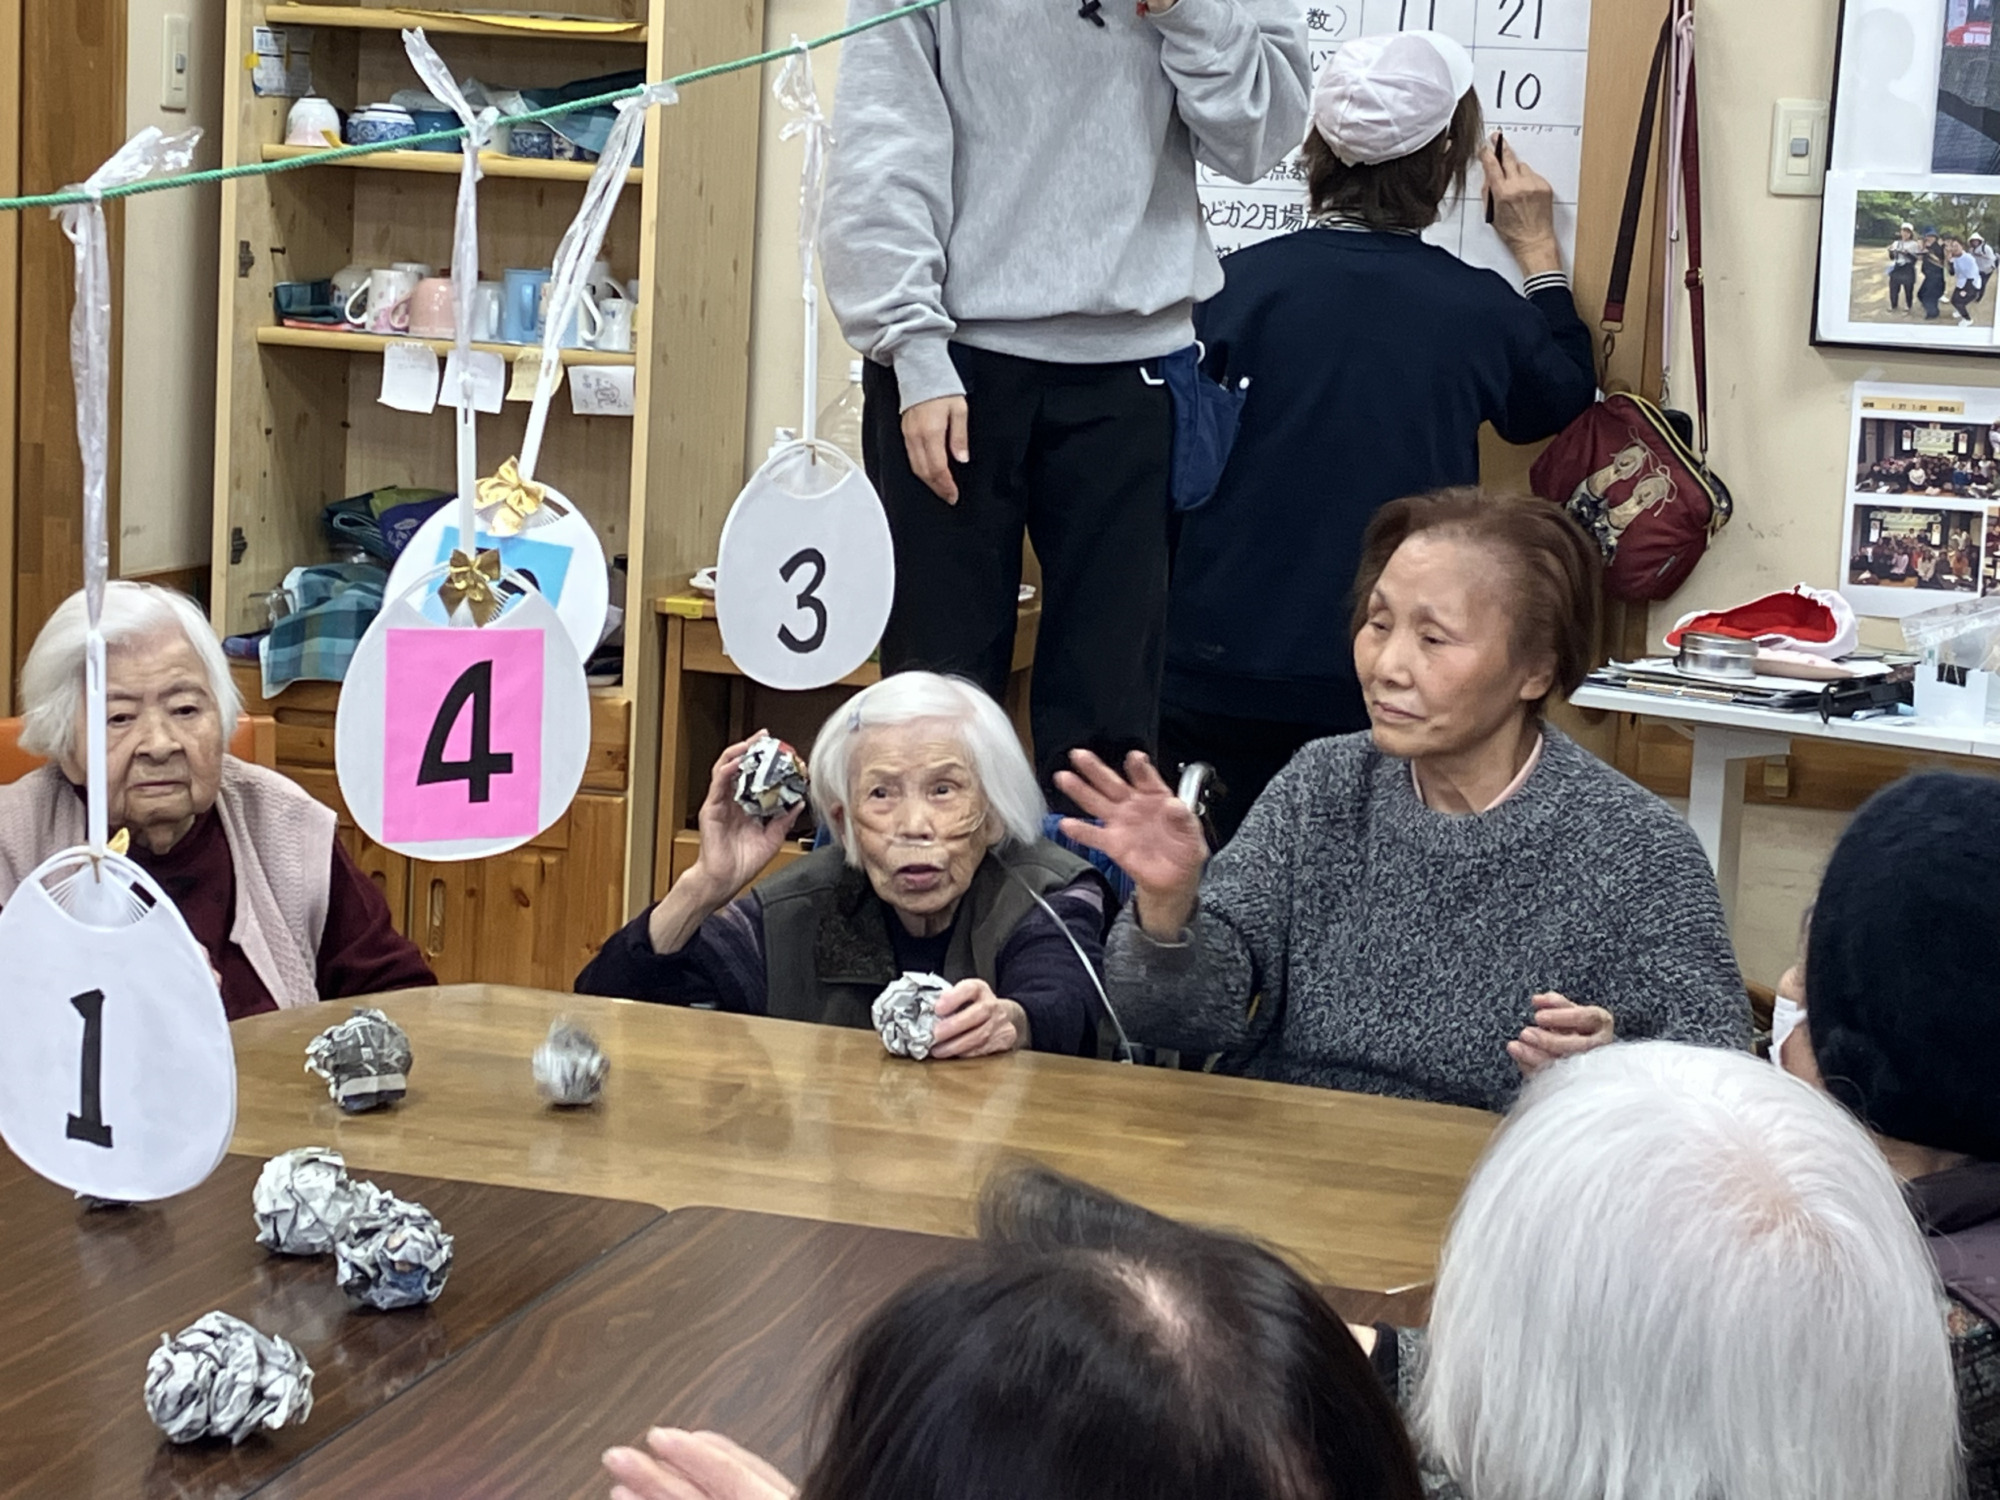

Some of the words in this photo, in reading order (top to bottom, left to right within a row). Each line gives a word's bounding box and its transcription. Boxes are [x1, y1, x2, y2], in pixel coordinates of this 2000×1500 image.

[1498, 0, 1543, 40] 21
[1496, 70, 1542, 110] 10
[777, 547, 827, 654] 3
[416, 659, 514, 803] 4
[65, 988, 113, 1148] 1
